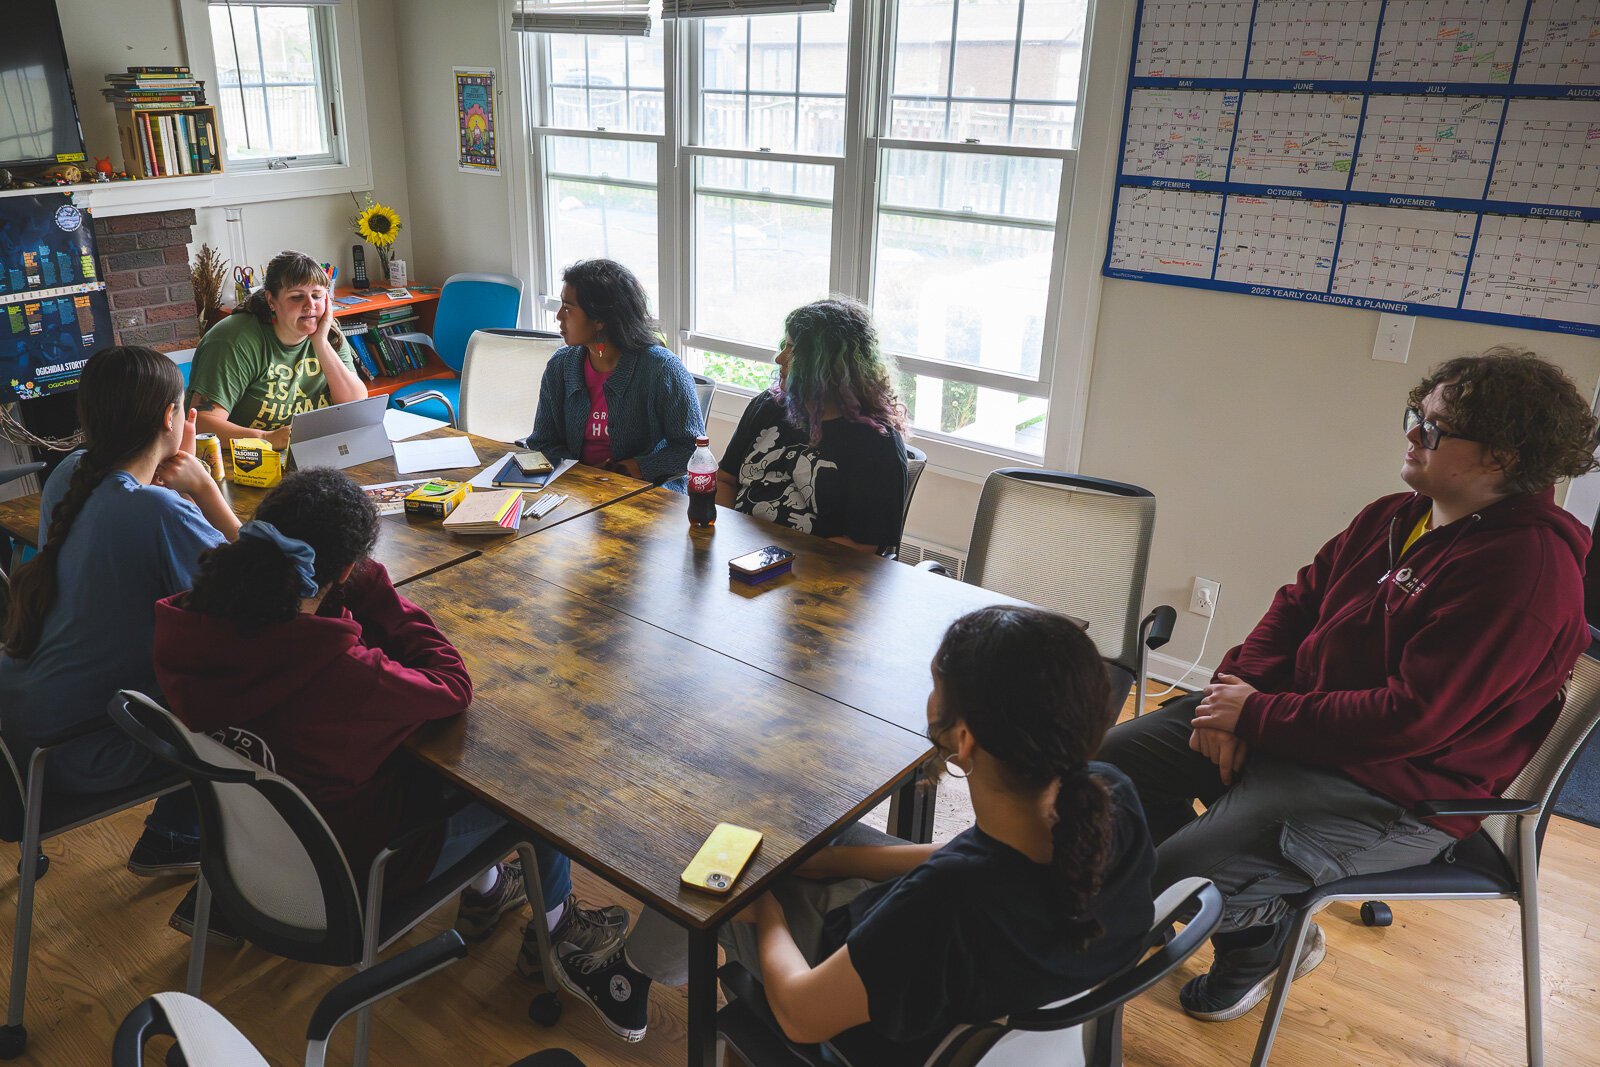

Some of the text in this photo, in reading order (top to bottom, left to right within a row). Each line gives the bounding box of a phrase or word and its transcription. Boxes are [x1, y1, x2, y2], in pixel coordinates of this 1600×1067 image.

[1152, 180, 1190, 189] SEPTEMBER
[1266, 188, 1302, 197] OCTOBER
[1390, 198, 1436, 207] NOVEMBER
[1530, 208, 1582, 217] DECEMBER
[1251, 286, 1408, 312] 2025 YEARLY CALENDAR & PLANNER
[267, 358, 320, 380] FOOD
[48, 379, 80, 388] OGICHIDA
[265, 382, 307, 400] IS A
[257, 394, 330, 421] HUMA
[593, 411, 608, 420] GR
